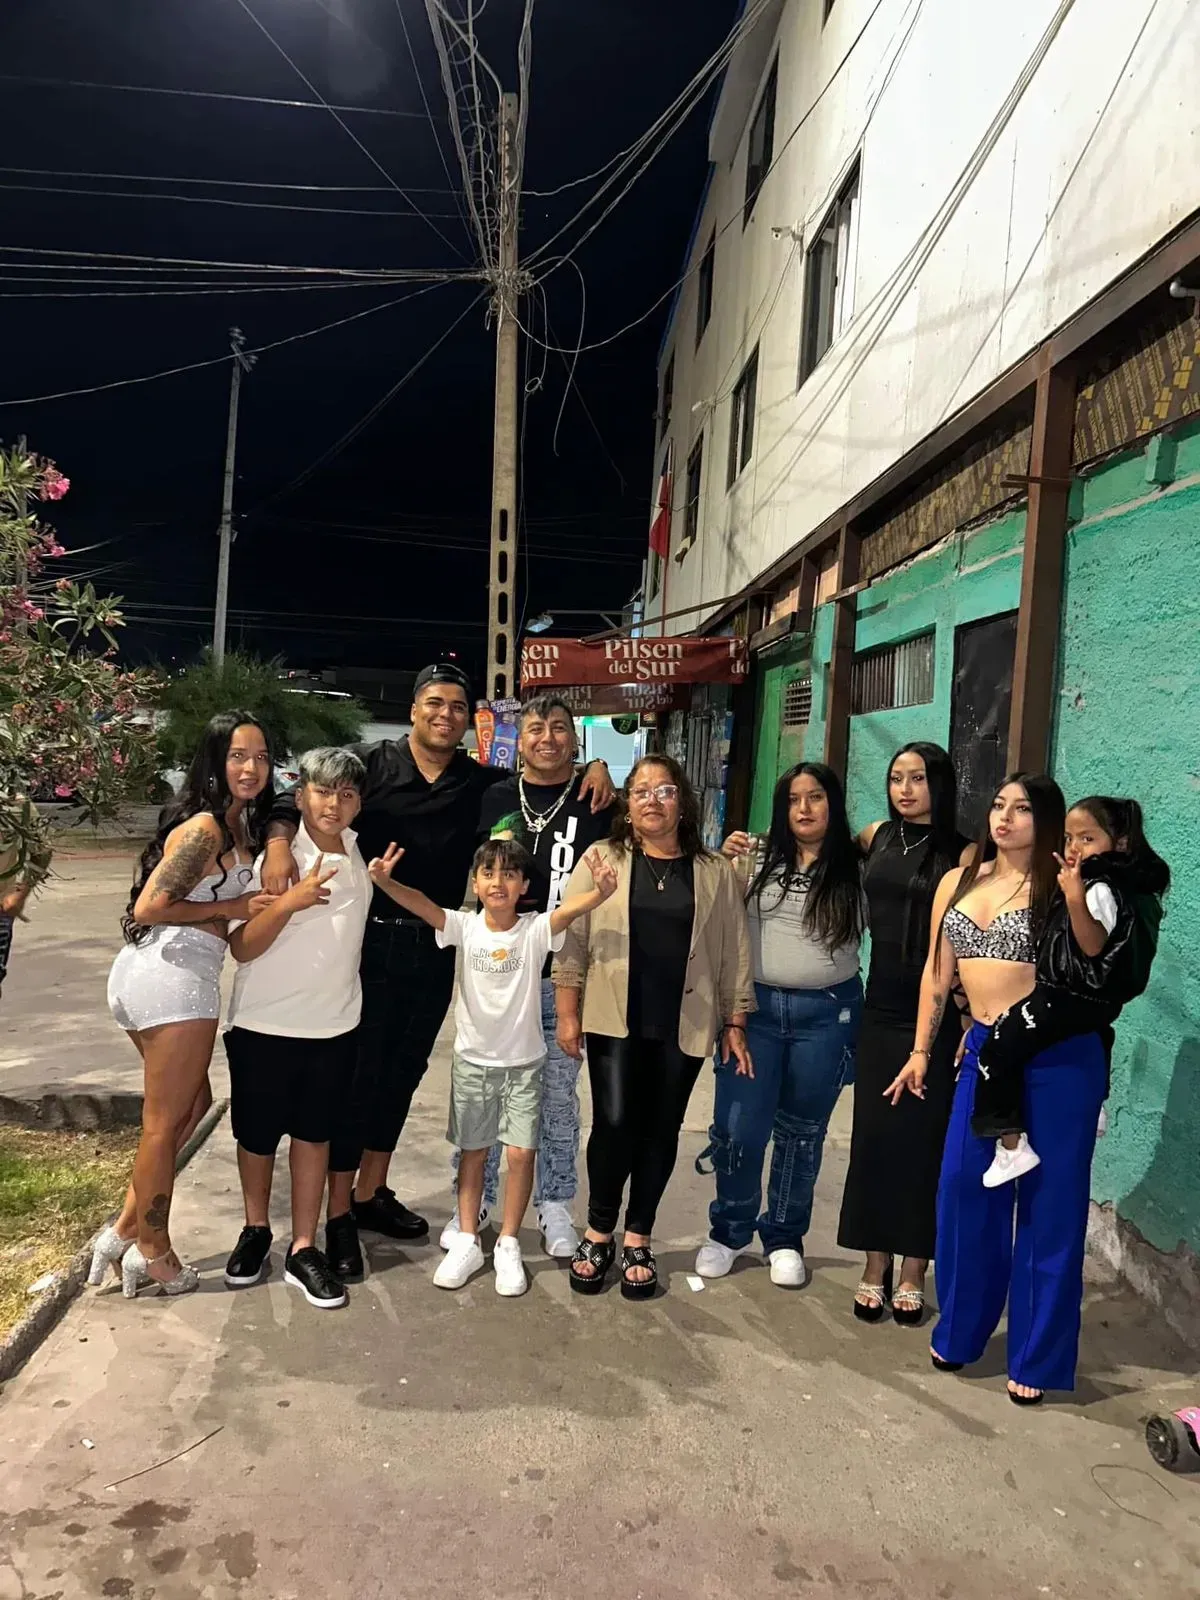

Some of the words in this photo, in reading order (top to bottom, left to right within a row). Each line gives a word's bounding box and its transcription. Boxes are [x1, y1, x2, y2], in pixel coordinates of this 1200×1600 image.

[604, 639, 683, 659] Pilsen
[608, 660, 633, 674] del
[636, 659, 680, 681] Sur
